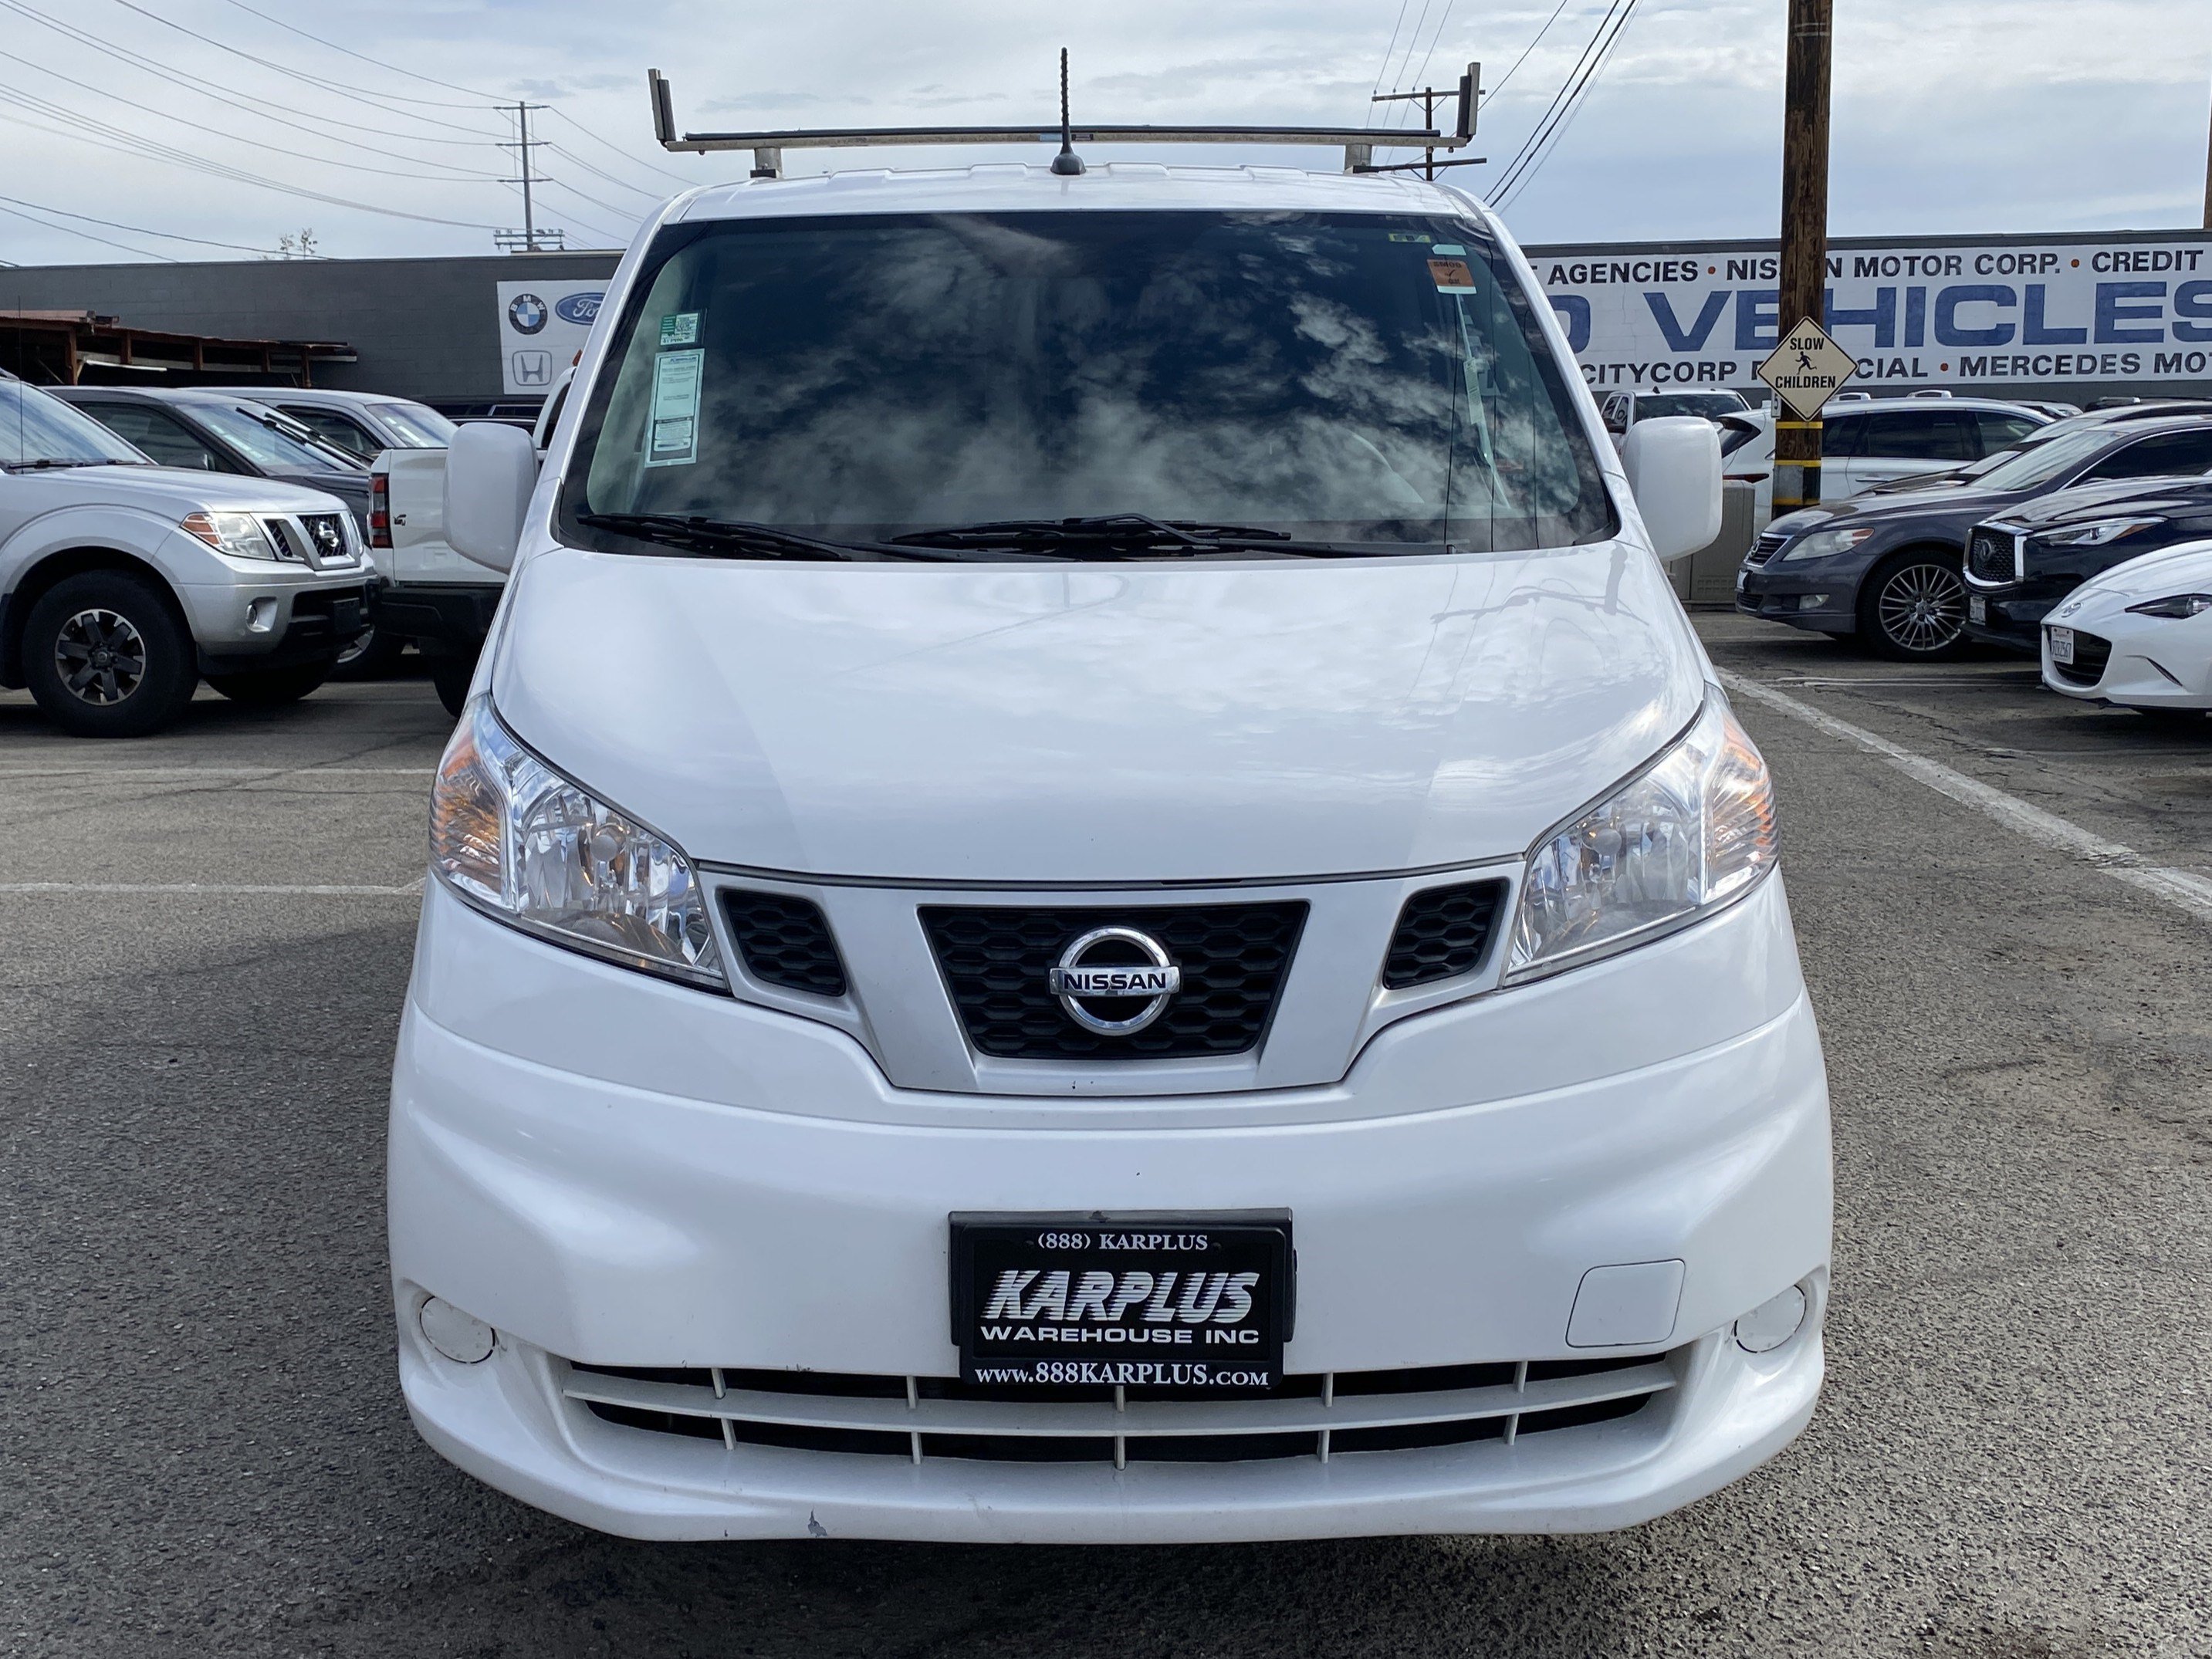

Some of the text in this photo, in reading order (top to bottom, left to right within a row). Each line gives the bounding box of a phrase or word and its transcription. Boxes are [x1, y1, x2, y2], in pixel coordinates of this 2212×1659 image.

[1547, 260, 1699, 285] AGENCIES
[1854, 254, 1962, 277] MOTOR
[1974, 253, 2060, 275] CORP.
[2092, 249, 2204, 273] CREDIT
[1790, 337, 1825, 350] SLOW
[1579, 361, 1737, 384] CITYCORP
[1959, 353, 2140, 377] MERCEDES
[2153, 350, 2212, 374] MO
[1775, 376, 1836, 388] CHILDREN
[1064, 973, 1166, 990] NISSAN
[1037, 1232, 1209, 1251] (888) KARPLUS
[979, 1269, 1260, 1324] KARPLUS
[979, 1326, 1260, 1345] WAREHOUSE INC
